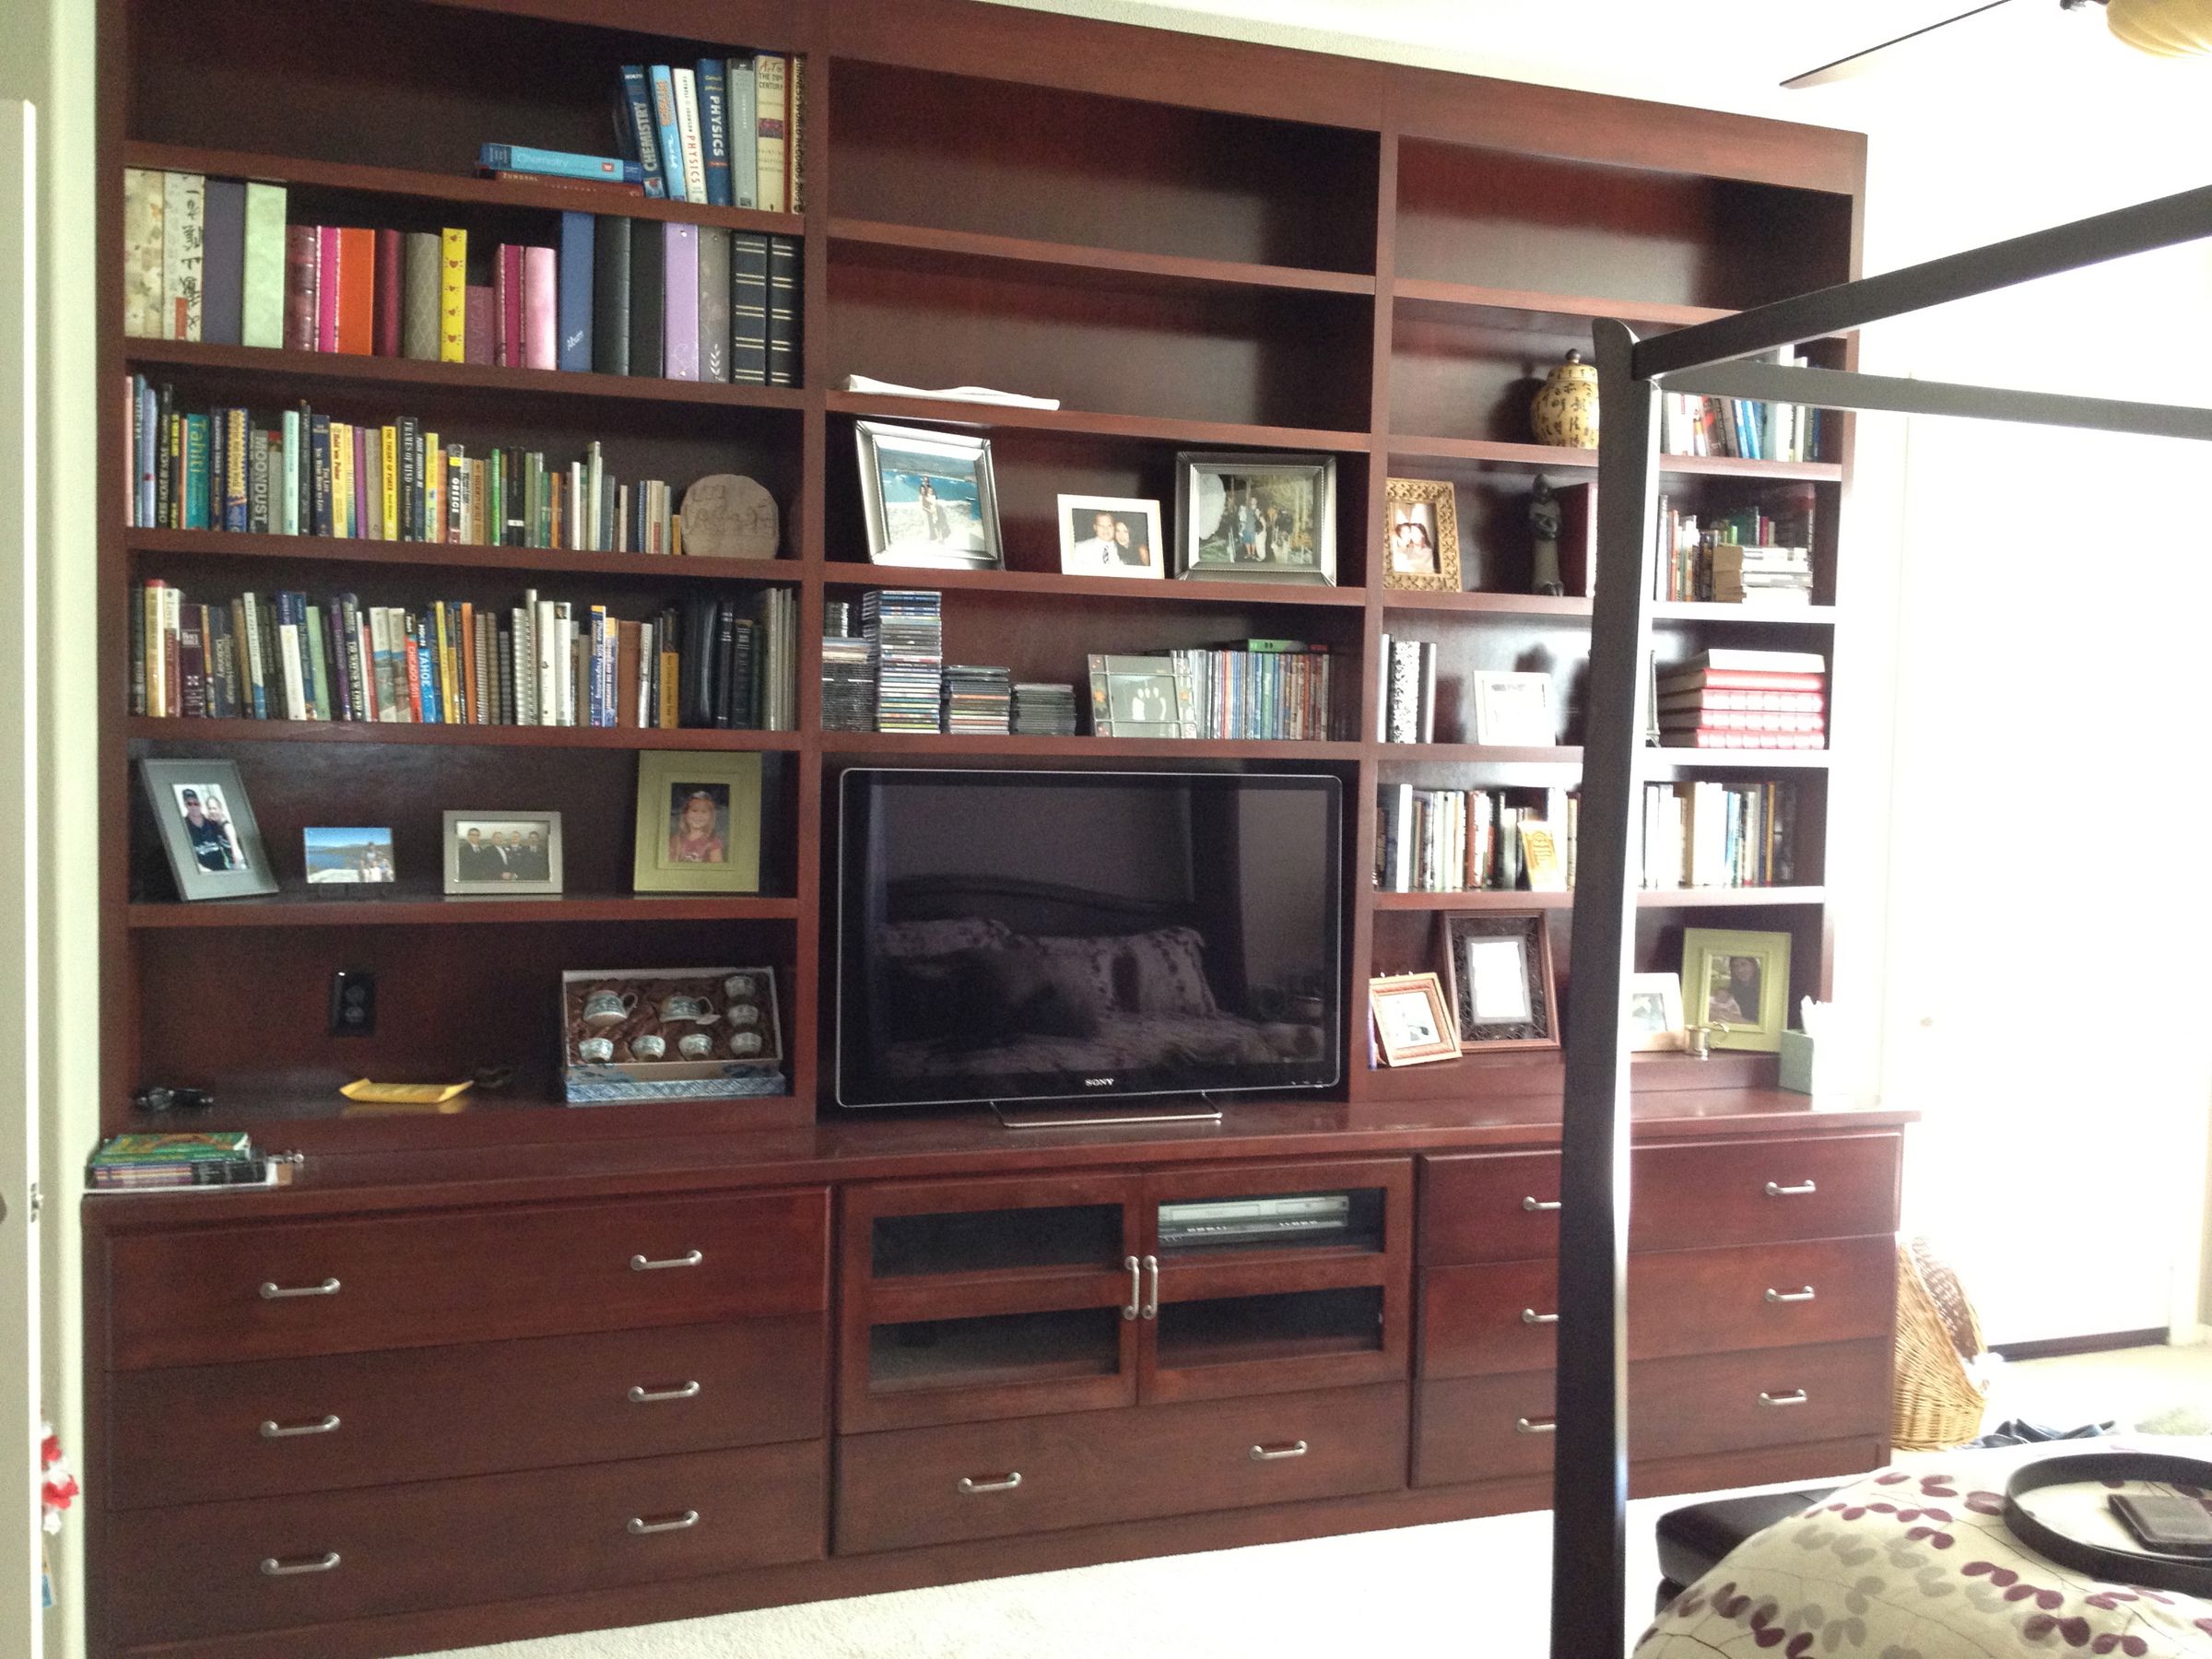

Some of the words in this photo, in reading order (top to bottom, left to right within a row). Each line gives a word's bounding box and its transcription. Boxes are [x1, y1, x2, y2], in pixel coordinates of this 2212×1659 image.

[633, 101, 657, 171] CHEMISTRY
[710, 95, 724, 157] PHYSICS
[687, 135, 701, 184] PHYSICS
[189, 419, 207, 473] Tahiti
[404, 421, 414, 451] FRAMES
[254, 436, 267, 524] MOONDUST
[404, 464, 414, 483] MIND
[452, 477, 460, 513] GREECE
[216, 639, 226, 678] Dictionary
[223, 633, 234, 671] American
[406, 645, 418, 681] CHICAGO
[418, 651, 430, 688] TAHOE
[226, 672, 236, 704] Heritage
[595, 657, 604, 699] Programming
[1085, 1078, 1114, 1087] SONY
